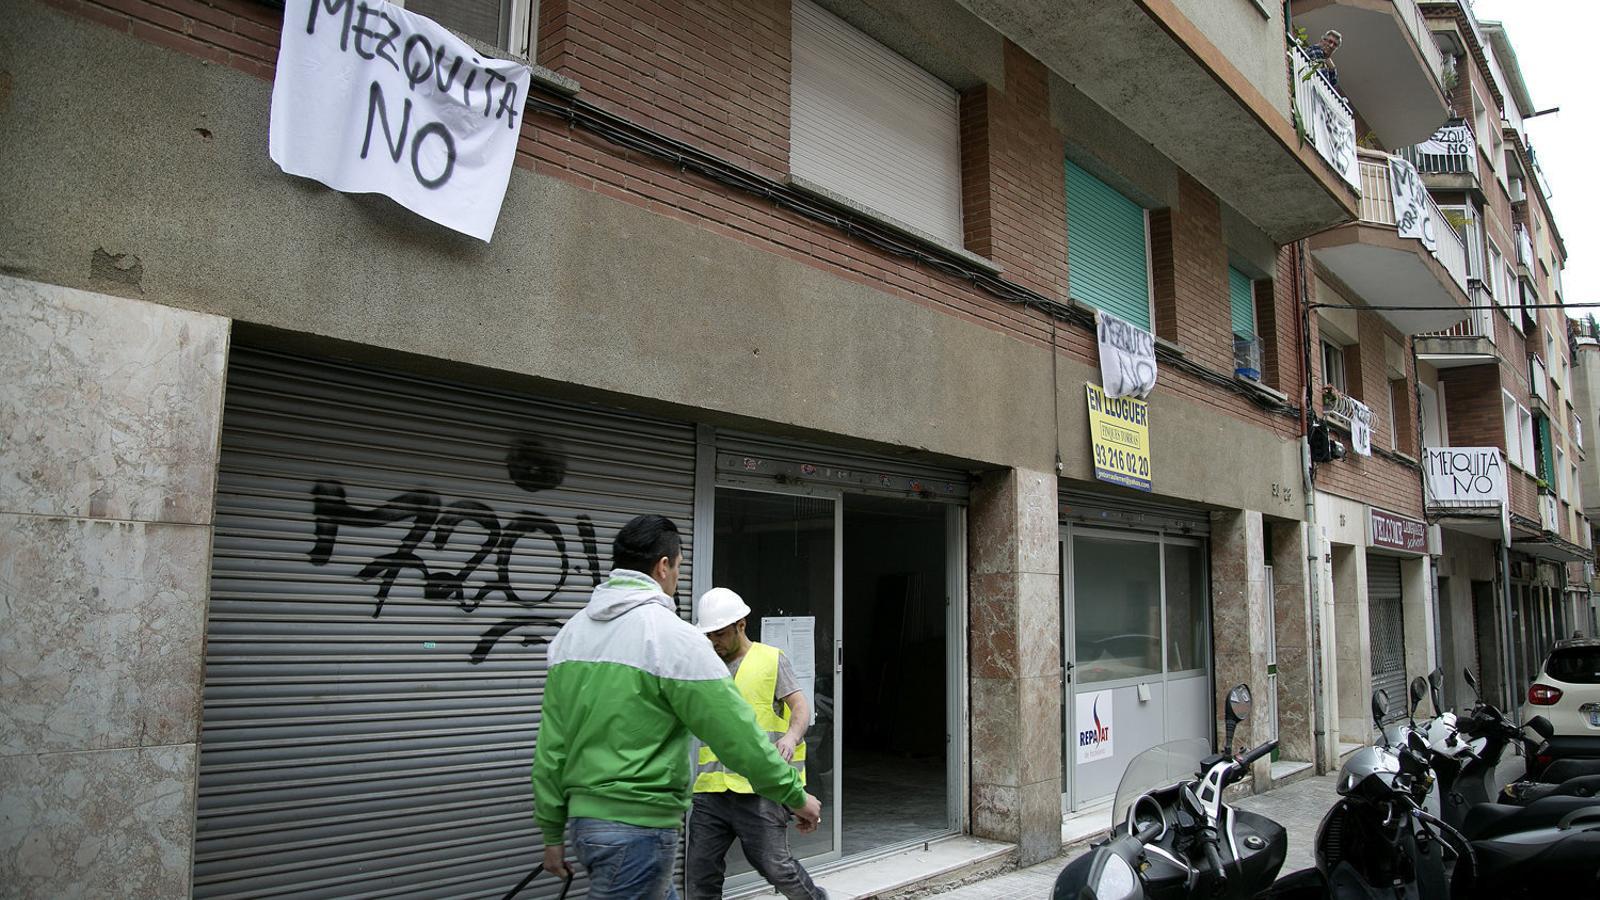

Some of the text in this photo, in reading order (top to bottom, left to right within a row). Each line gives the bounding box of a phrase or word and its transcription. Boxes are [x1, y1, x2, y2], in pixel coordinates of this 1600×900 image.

[360, 80, 457, 190] NO
[1447, 143, 1468, 154] NO
[1089, 387, 1147, 428] EN LLOGUER
[1095, 443, 1149, 477] 93 216 02 20
[1430, 451, 1501, 476] MEZQUITA
[1453, 475, 1493, 495] NO
